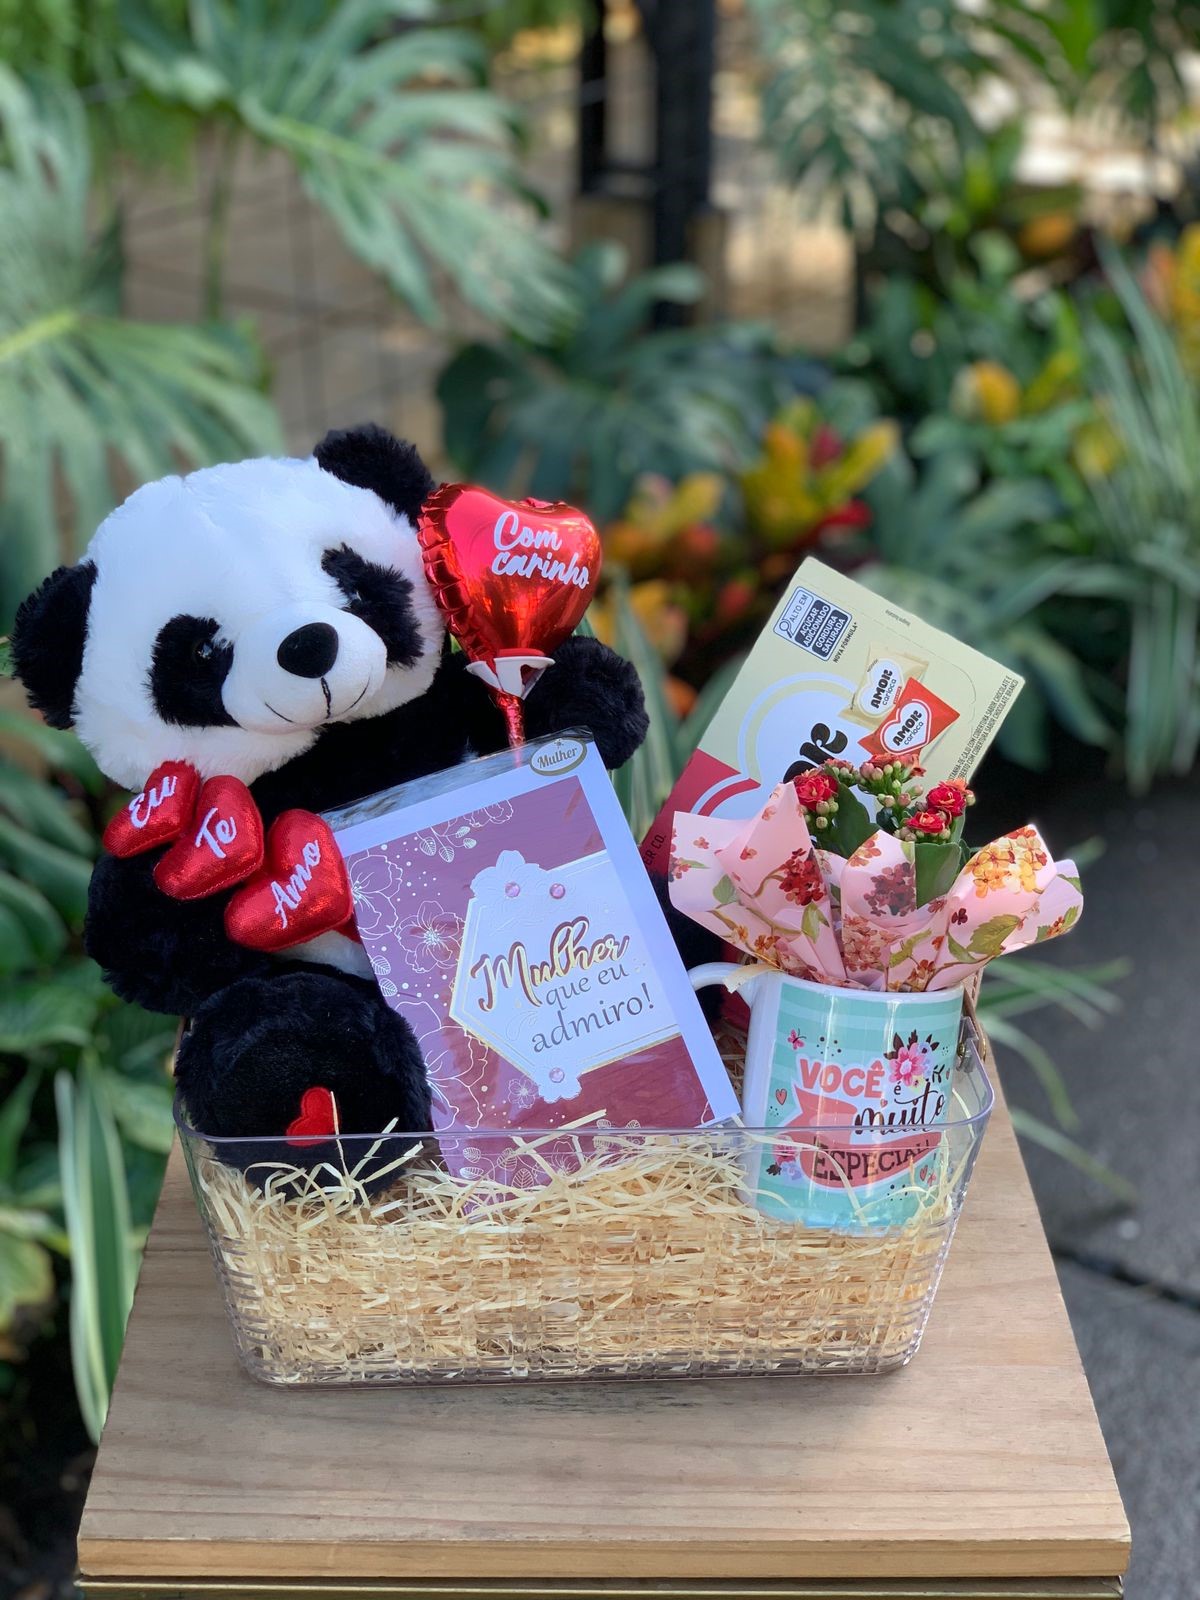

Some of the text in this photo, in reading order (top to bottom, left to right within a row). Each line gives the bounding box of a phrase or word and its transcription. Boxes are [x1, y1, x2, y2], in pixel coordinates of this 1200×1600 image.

[494, 511, 562, 551] Com
[491, 552, 590, 590] carinho
[789, 594, 809, 623] ALTO EM
[803, 605, 830, 646] ADICIONADO
[815, 615, 838, 648] GORDURA
[821, 619, 846, 653] SATURADA
[833, 648, 845, 663] NOVA
[871, 669, 893, 709] AMOR
[882, 679, 897, 705] carioca
[992, 677, 1010, 702] CHOCOLATE
[892, 710, 922, 746] AMOR
[904, 722, 923, 745] carioca
[971, 730, 989, 755] COBERTURA
[984, 717, 996, 732] SABOR
[991, 693, 1010, 719] CHOCOLATE
[1004, 678, 1018, 696] BRANCO
[537, 747, 578, 769] Mulher
[129, 776, 177, 828] Eu
[195, 807, 236, 858] Te
[271, 840, 320, 929] Amo
[470, 915, 630, 1011] Mulher
[546, 963, 629, 1010] que eu
[532, 983, 654, 1053] admiro!
[800, 1060, 885, 1098] VOCÊ
[893, 1081, 901, 1095] é
[855, 1081, 945, 1135] muito
